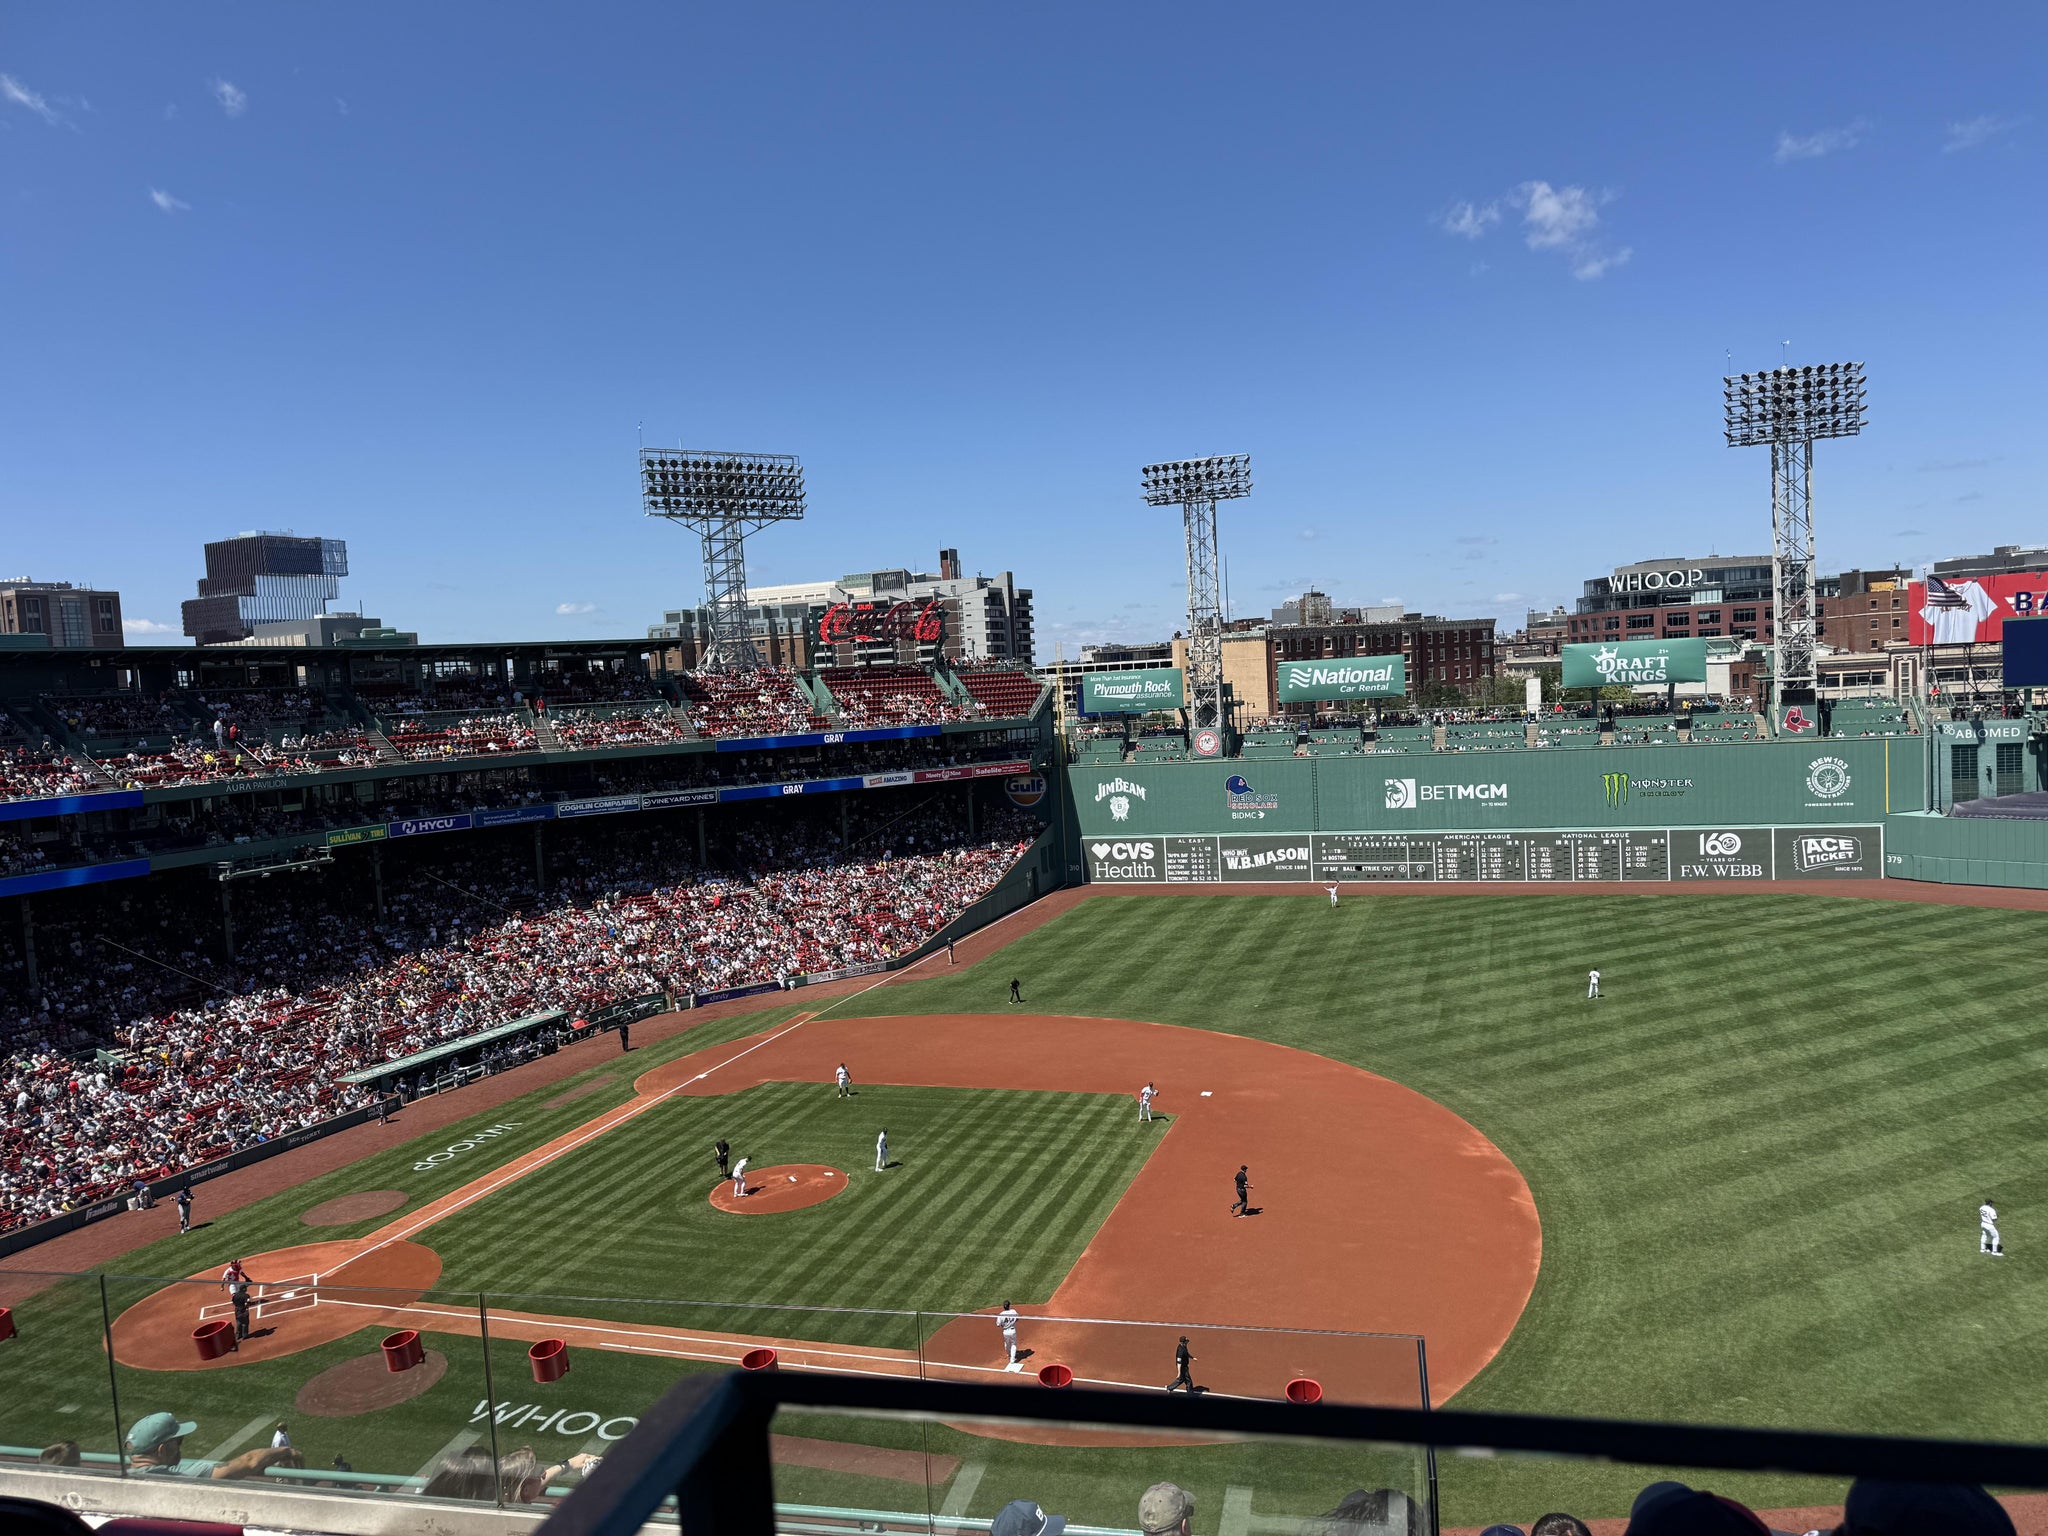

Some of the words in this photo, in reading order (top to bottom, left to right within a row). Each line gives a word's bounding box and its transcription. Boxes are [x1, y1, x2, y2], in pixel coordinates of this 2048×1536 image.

[1608, 569, 1702, 593] WHOOP
[1595, 656, 1669, 674] DRAFT
[1605, 669, 1667, 683] KINGS
[1093, 682, 1142, 697] Plymouth
[1144, 680, 1171, 692] Rock
[1359, 683, 1389, 692] Rental
[824, 733, 844, 744] GRAY
[1955, 727, 2020, 739] ABIOMED
[1808, 756, 1832, 770] IBEW
[1833, 758, 1848, 770] 103
[975, 767, 1002, 775] Safelite
[226, 783, 252, 792] AURA
[253, 779, 287, 789] PAVILION
[884, 775, 907, 784] AMAZING
[1007, 779, 1044, 793] Gulf
[1631, 779, 1694, 788] MONSTER
[783, 784, 804, 794] GRAY
[1421, 784, 1507, 800] BETMGM
[1806, 777, 1815, 792] NECA
[1814, 776, 1851, 799] CONTRACTORS
[560, 803, 593, 812] COGHLIN
[594, 798, 637, 808] COMPANIES
[650, 795, 690, 805] VINEYARD
[1232, 794, 1252, 802] RED
[1232, 811, 1256, 819] BIDMC
[419, 819, 453, 831] HYCU
[329, 832, 361, 843] SULLIVAN
[370, 829, 384, 837] TIRE
[1112, 842, 1155, 860] CVS
[1700, 833, 1741, 855] 160
[1807, 838, 1854, 854] ACE
[1807, 851, 1854, 864] TICKET
[1887, 856, 1902, 864] 379
[1095, 862, 1156, 878] Health
[1680, 865, 1709, 877] F.W.
[1713, 864, 1763, 876] WEBB
[709, 992, 729, 1002] xfinity
[301, 1130, 320, 1141] TICKET
[413, 1122, 523, 1171] WHOOP
[190, 1162, 229, 1181] smartwater
[85, 1202, 118, 1222] Franklin
[1035, 1504, 1044, 1520] B
